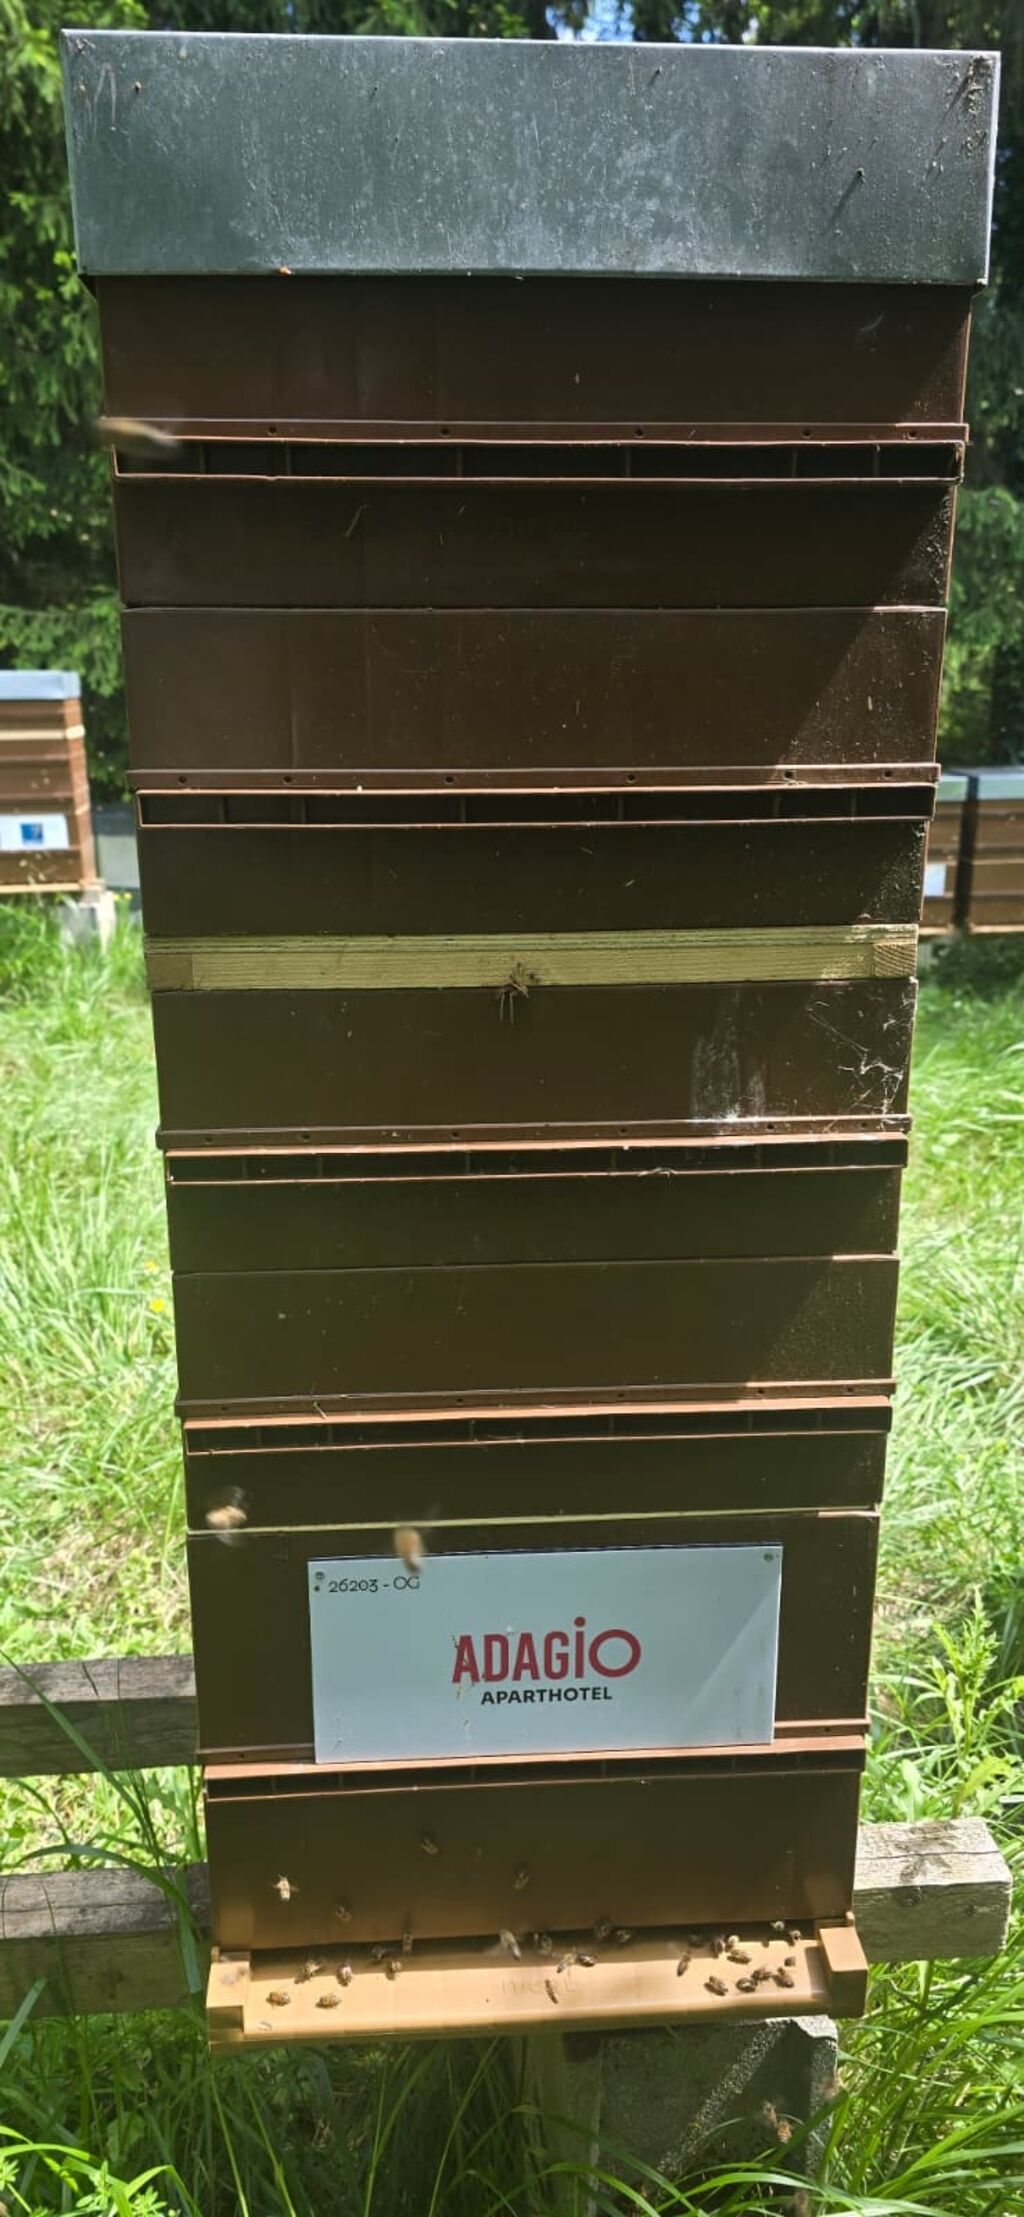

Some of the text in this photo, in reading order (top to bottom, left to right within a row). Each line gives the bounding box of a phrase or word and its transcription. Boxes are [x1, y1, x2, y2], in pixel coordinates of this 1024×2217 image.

[328, 1577, 379, 1593] 26203
[393, 1575, 420, 1591] OG
[481, 1687, 613, 1705] APARTHOTEL
